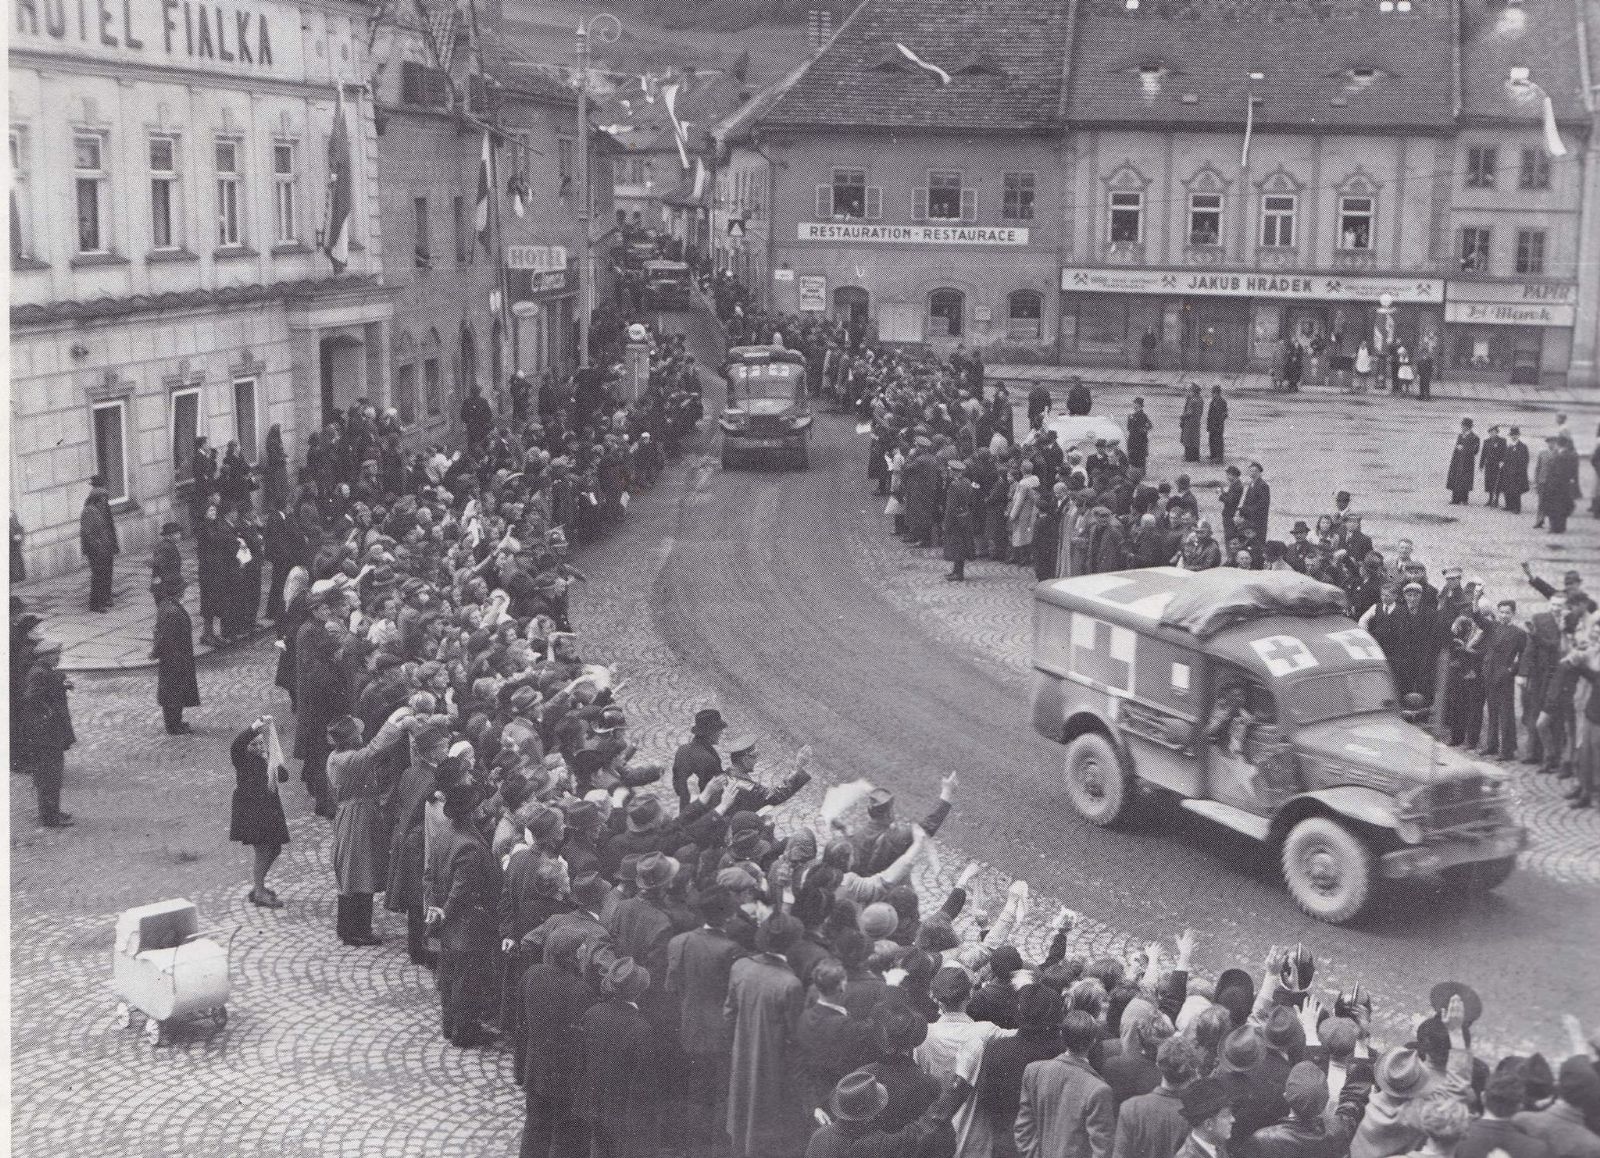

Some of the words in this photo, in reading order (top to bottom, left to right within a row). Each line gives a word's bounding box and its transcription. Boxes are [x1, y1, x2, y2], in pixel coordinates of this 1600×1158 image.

[162, 0, 272, 66] FIALKA
[809, 225, 911, 240] RESTAURATION
[923, 227, 1015, 242] RESTAURACE
[511, 248, 564, 267] HOTEL
[1187, 275, 1241, 291] JAKUB
